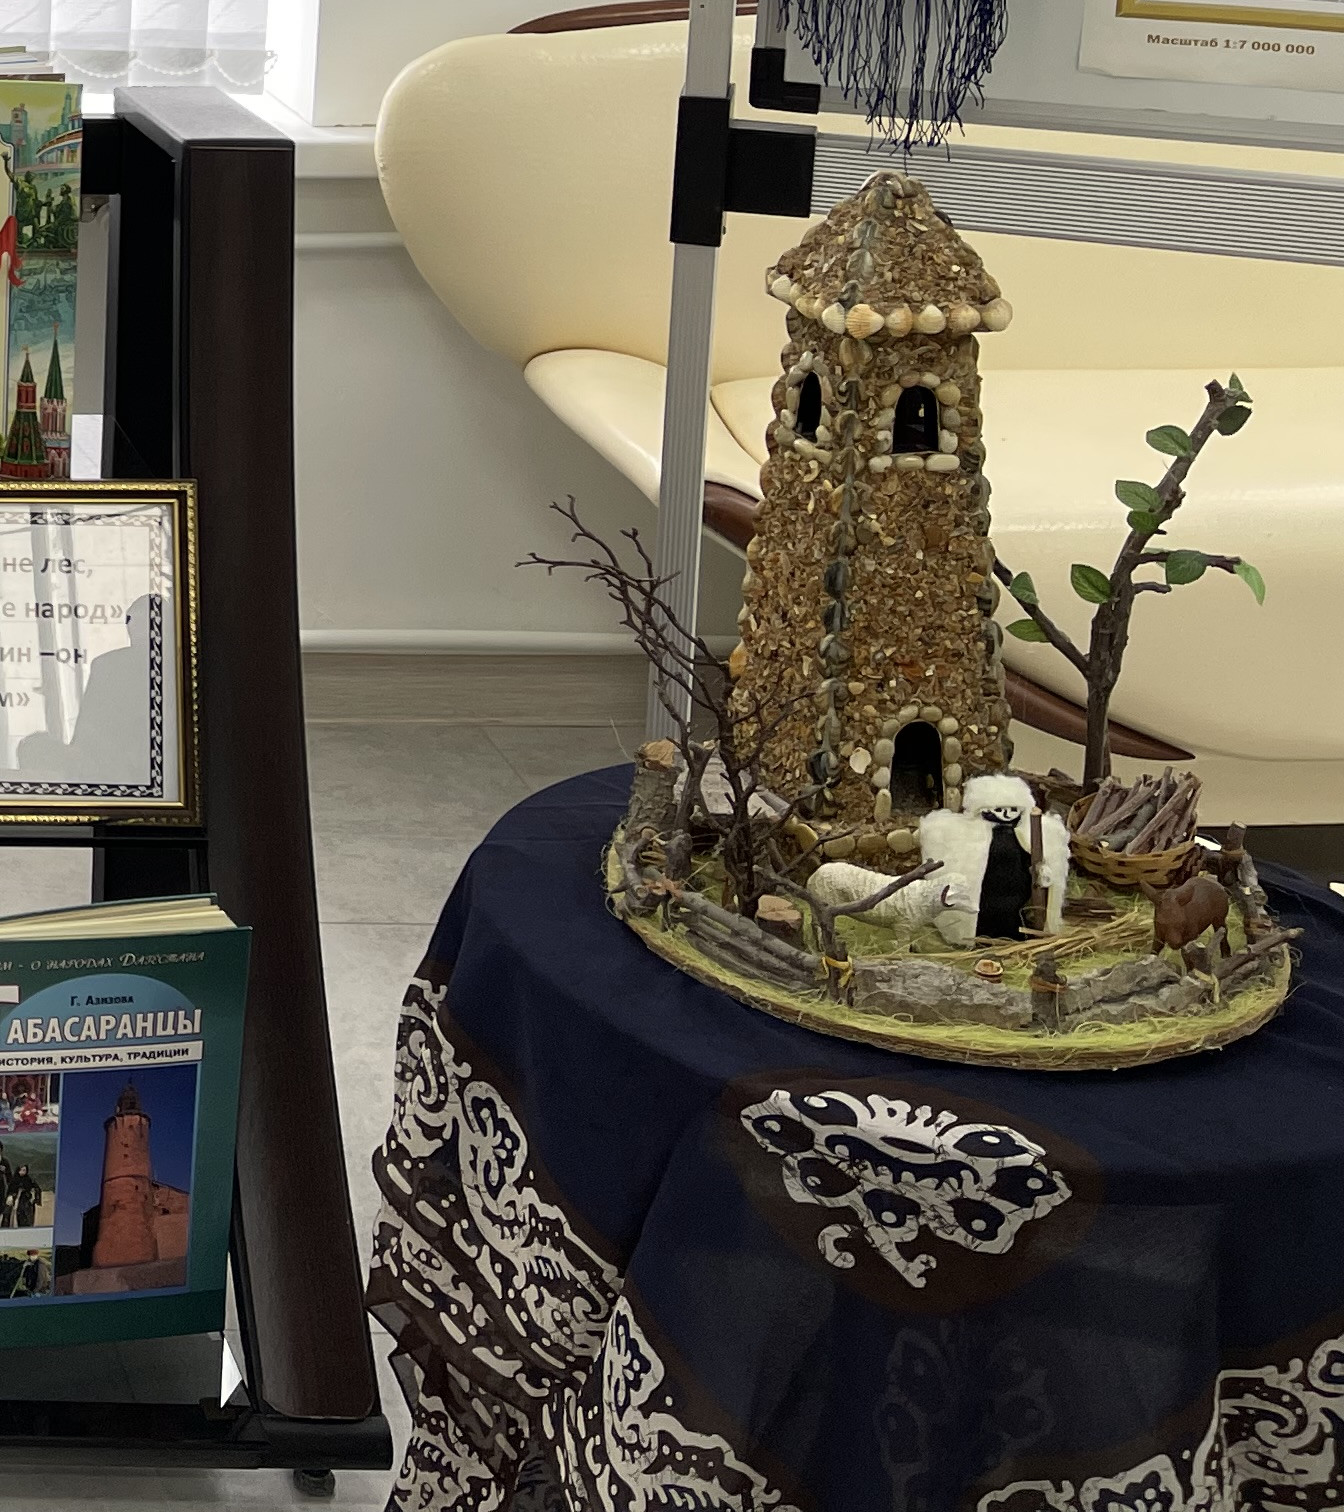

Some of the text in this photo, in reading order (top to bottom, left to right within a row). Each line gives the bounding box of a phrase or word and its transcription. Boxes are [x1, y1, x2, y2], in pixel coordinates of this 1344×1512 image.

[1147, 34, 1316, 55] Масштаб 1:7 000 000
[2, 555, 33, 574] не
[40, 556, 93, 578] лес,
[70, 996, 81, 1007] Г.
[60, 1053, 124, 1065] КУЛЬТУРА,
[127, 1048, 189, 1061] ТРАДИЦИИ
